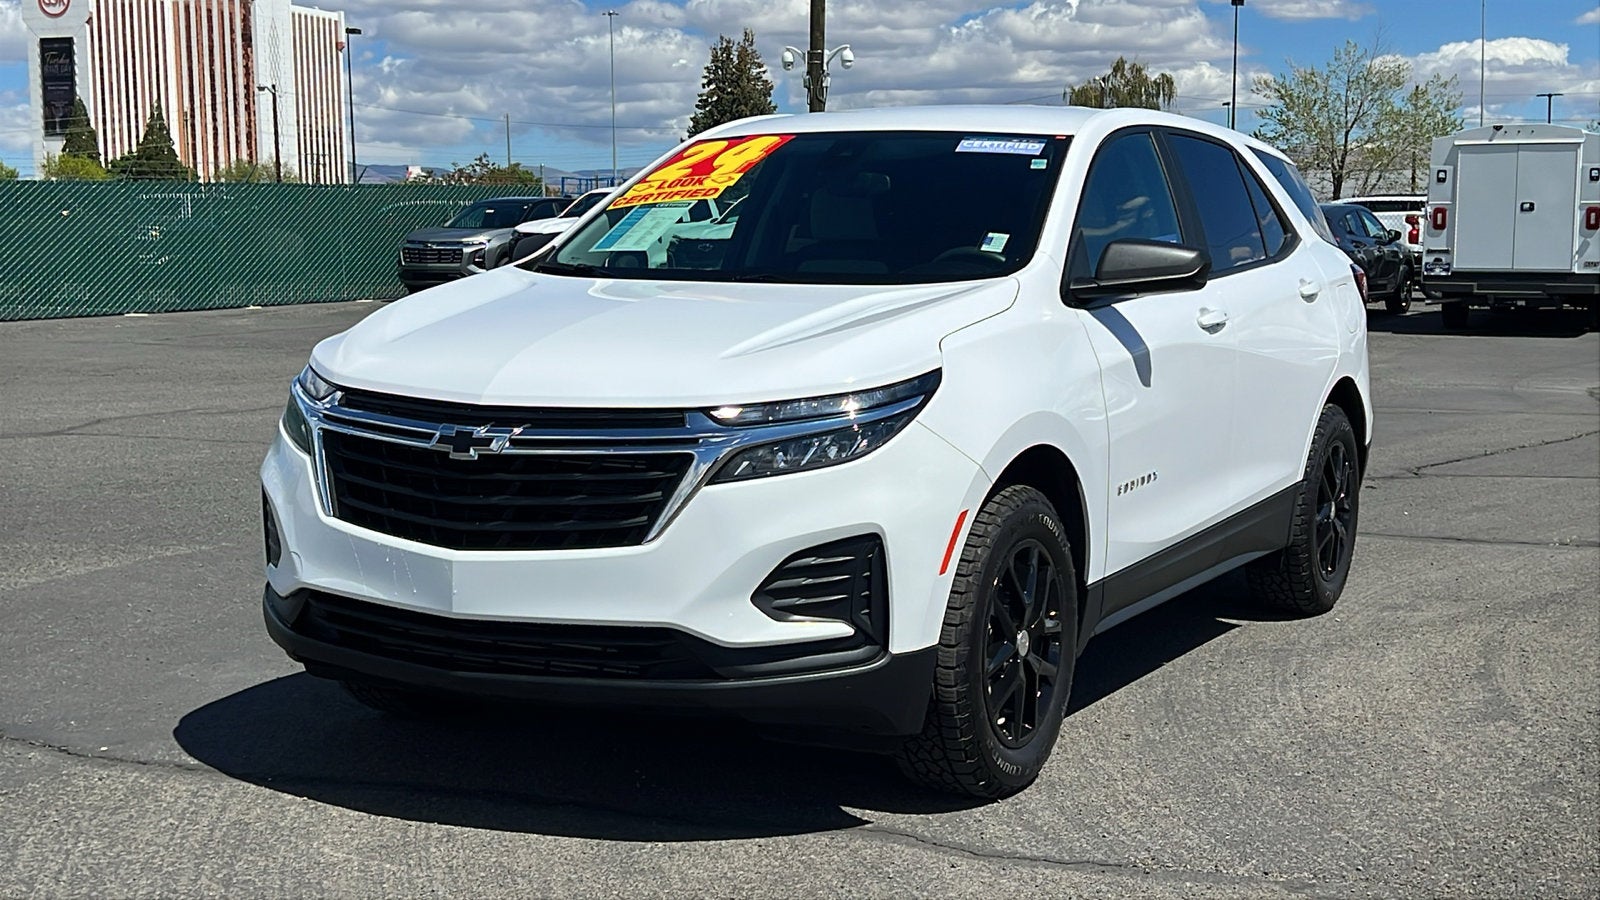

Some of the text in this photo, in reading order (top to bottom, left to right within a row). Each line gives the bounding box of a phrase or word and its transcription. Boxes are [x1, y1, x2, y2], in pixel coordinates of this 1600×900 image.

[962, 139, 1040, 150] CERTIFIED
[645, 136, 782, 181] 24
[655, 176, 706, 191] LOOK
[612, 187, 720, 207] CERTIFIED
